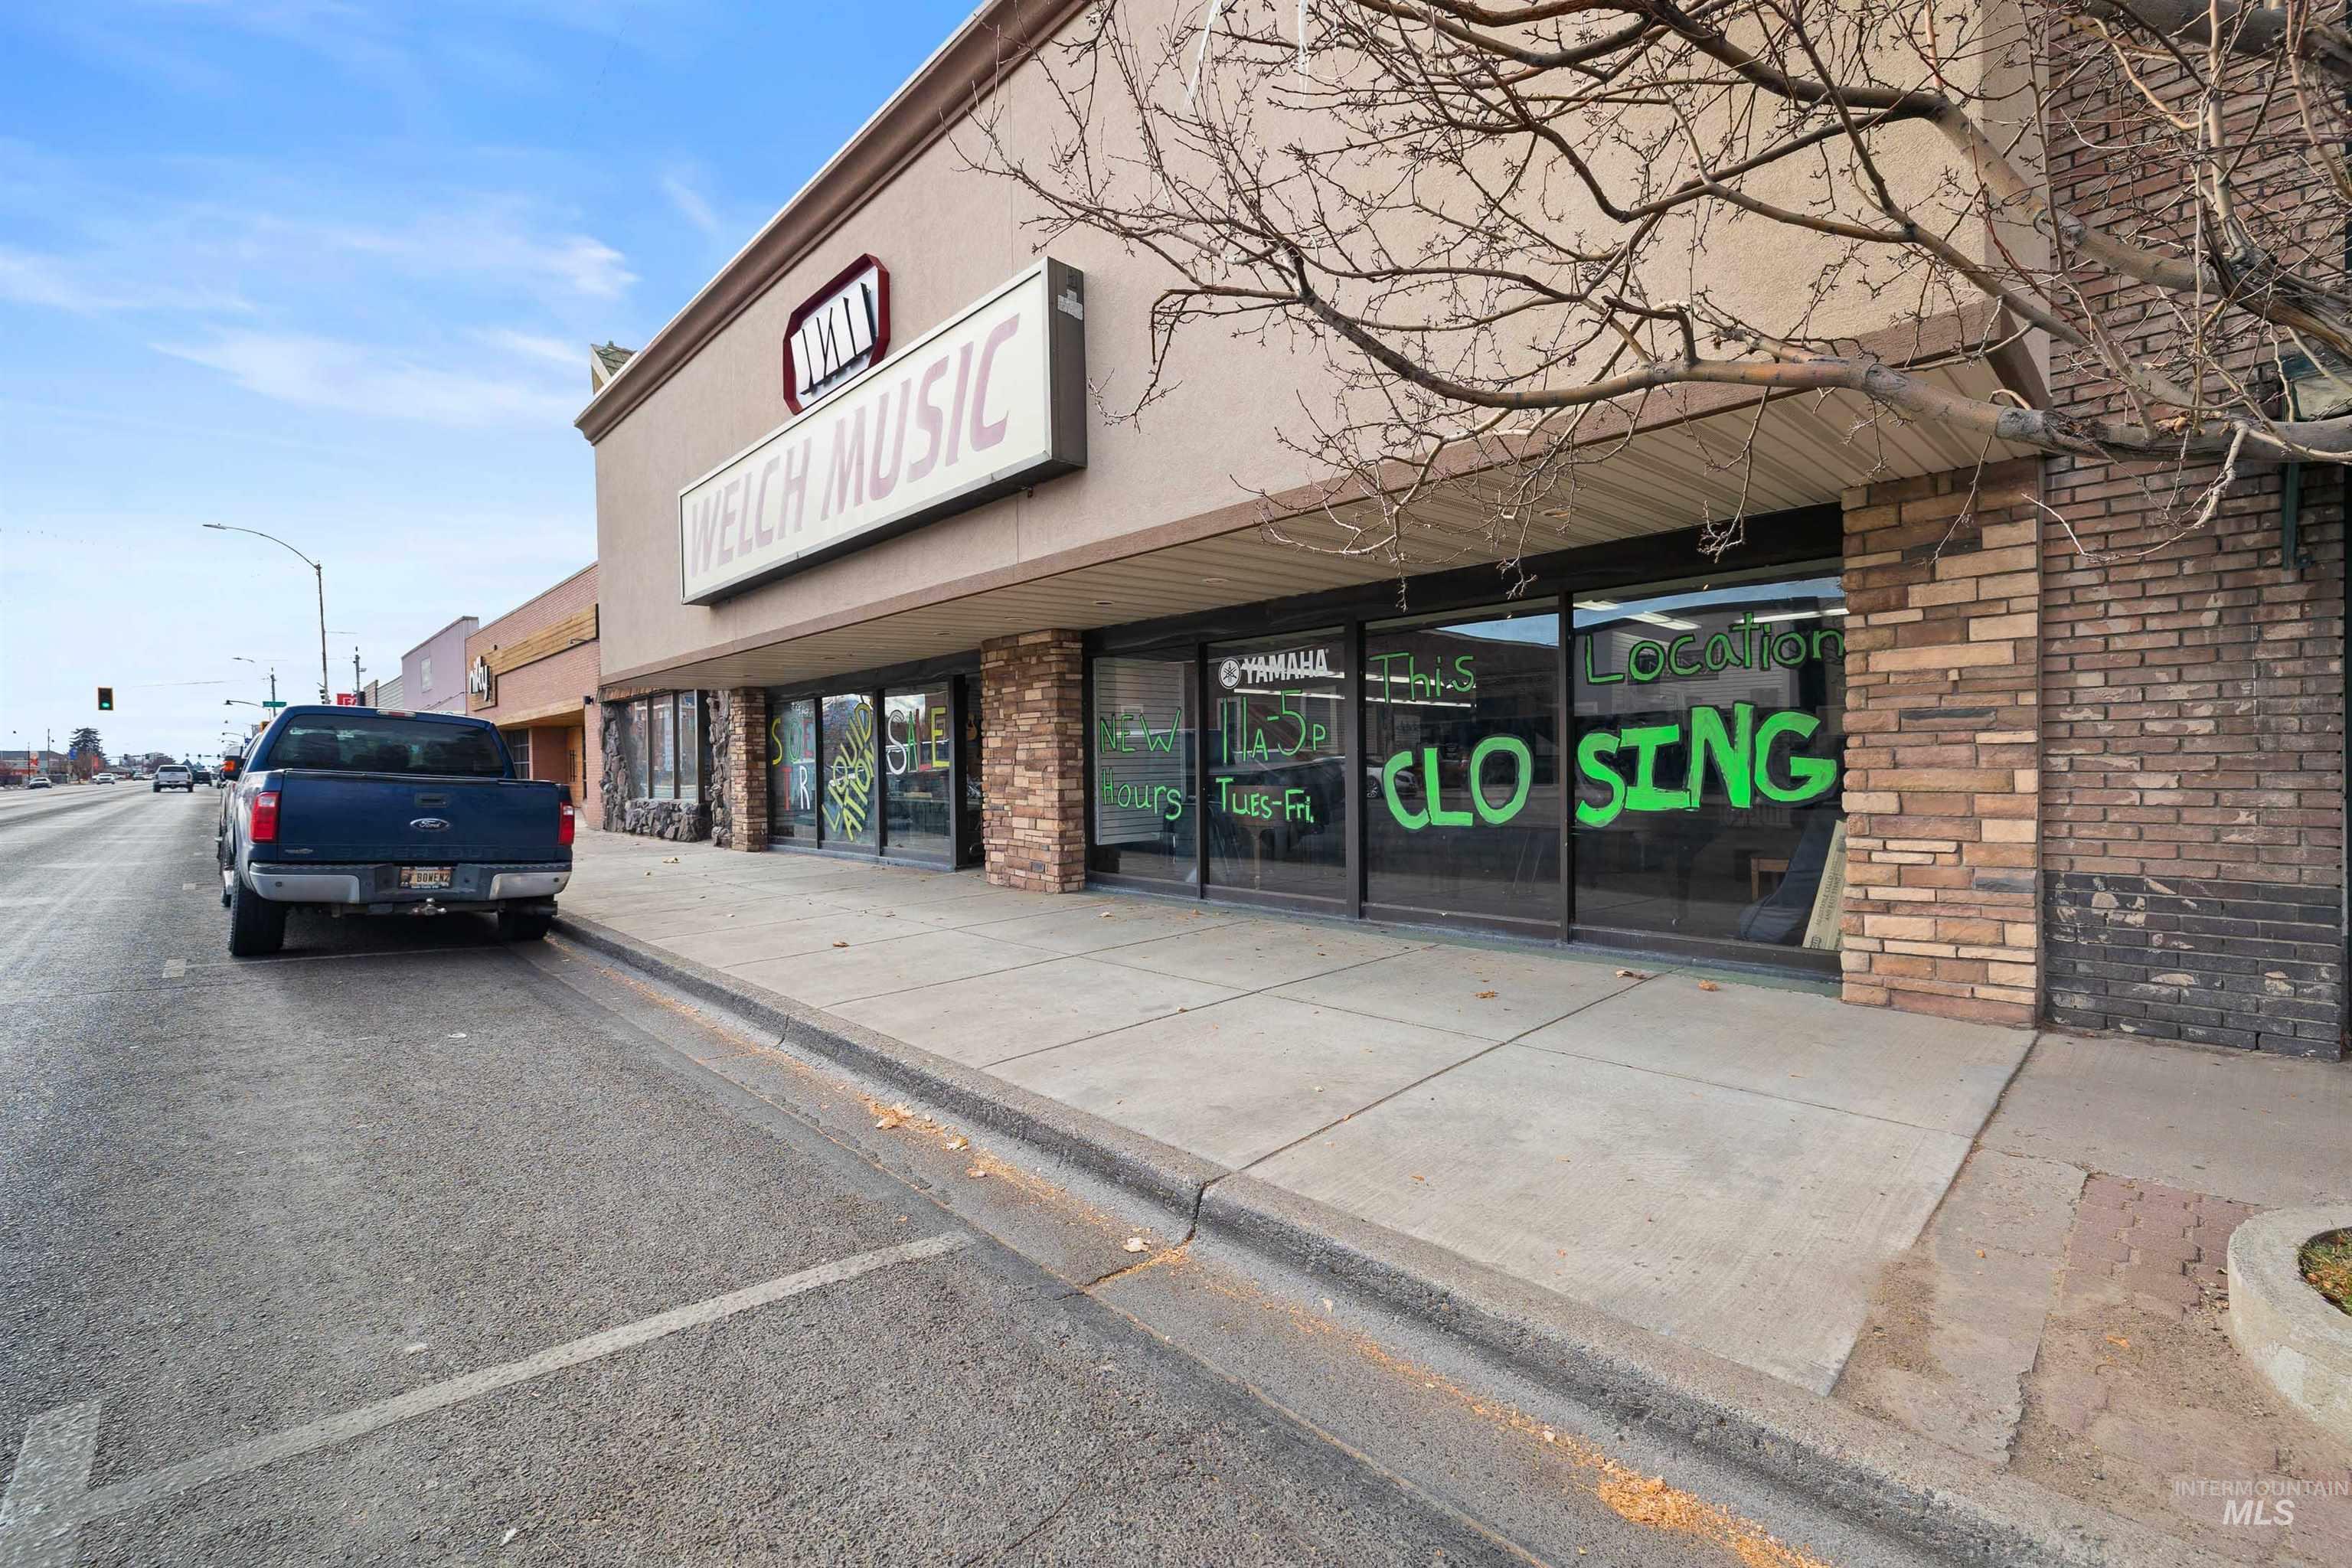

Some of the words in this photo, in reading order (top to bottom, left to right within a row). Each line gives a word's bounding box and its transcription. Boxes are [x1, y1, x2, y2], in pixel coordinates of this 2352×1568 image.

[691, 436, 812, 578] WELCH
[821, 313, 1021, 521] MUSIC
[1241, 648, 1328, 684] YAMAHA
[1369, 652, 1475, 704] This
[1585, 612, 1844, 684] Location
[887, 707, 950, 776] SALE
[1100, 707, 1181, 753] NEW
[1102, 768, 1183, 820] Hours
